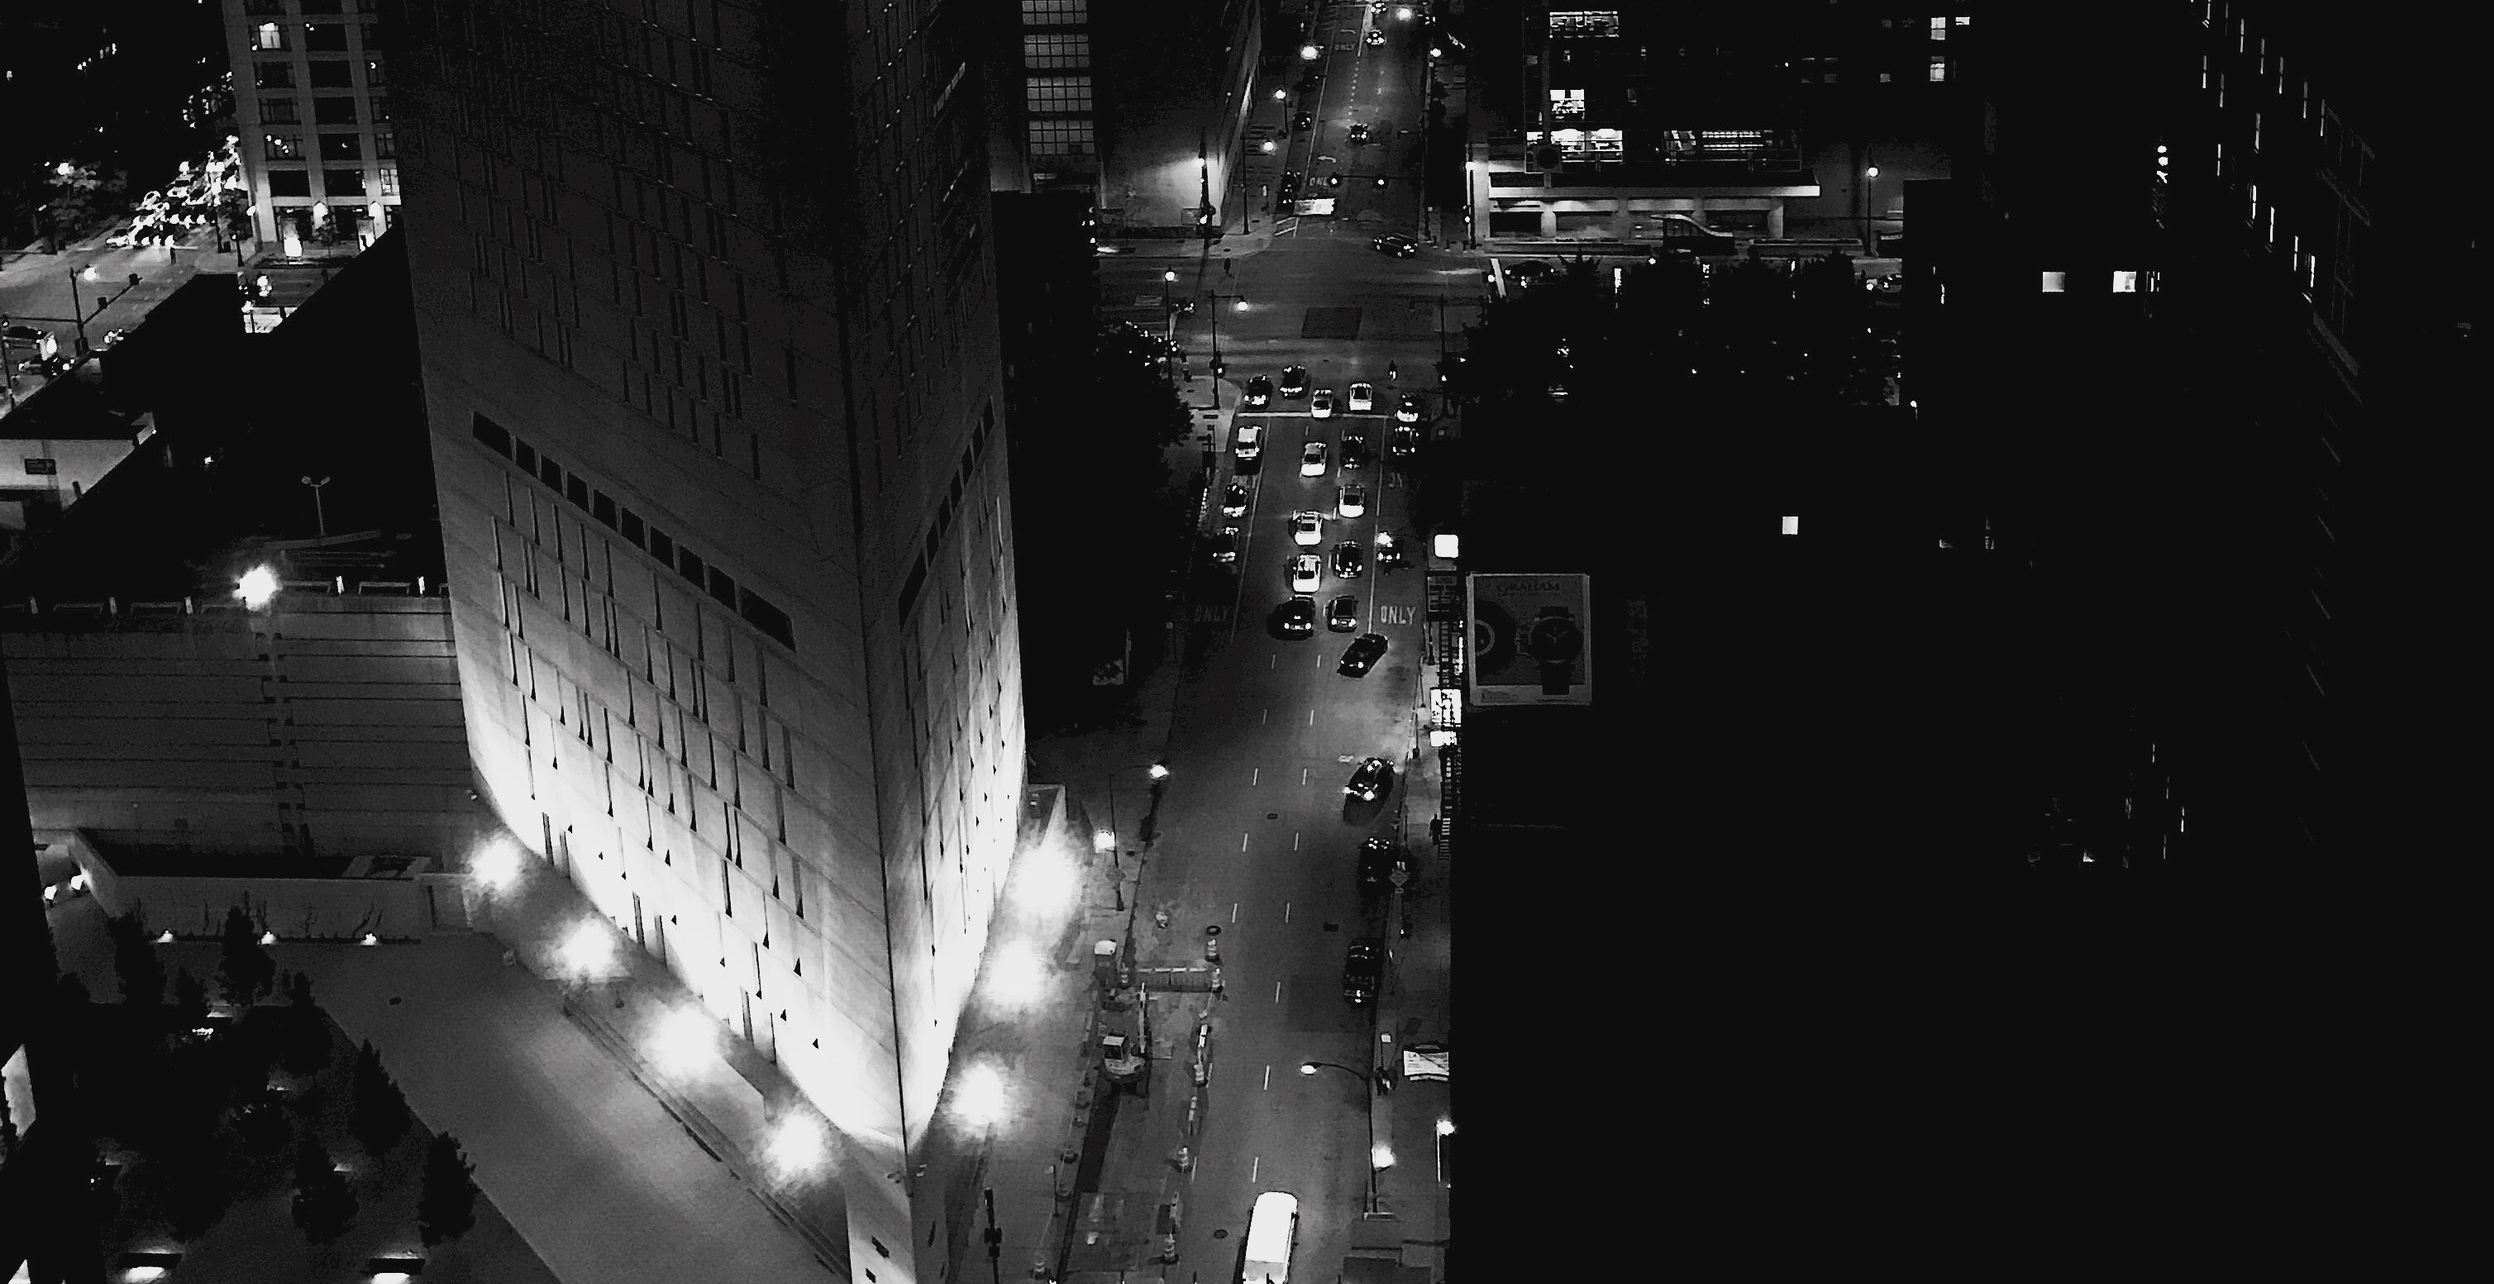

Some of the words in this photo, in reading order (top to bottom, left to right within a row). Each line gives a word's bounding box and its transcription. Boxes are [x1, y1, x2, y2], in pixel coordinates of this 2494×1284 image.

[1309, 177, 1329, 186] ONL
[1497, 582, 1559, 591] GRAHAM
[1381, 606, 1416, 625] ONLY
